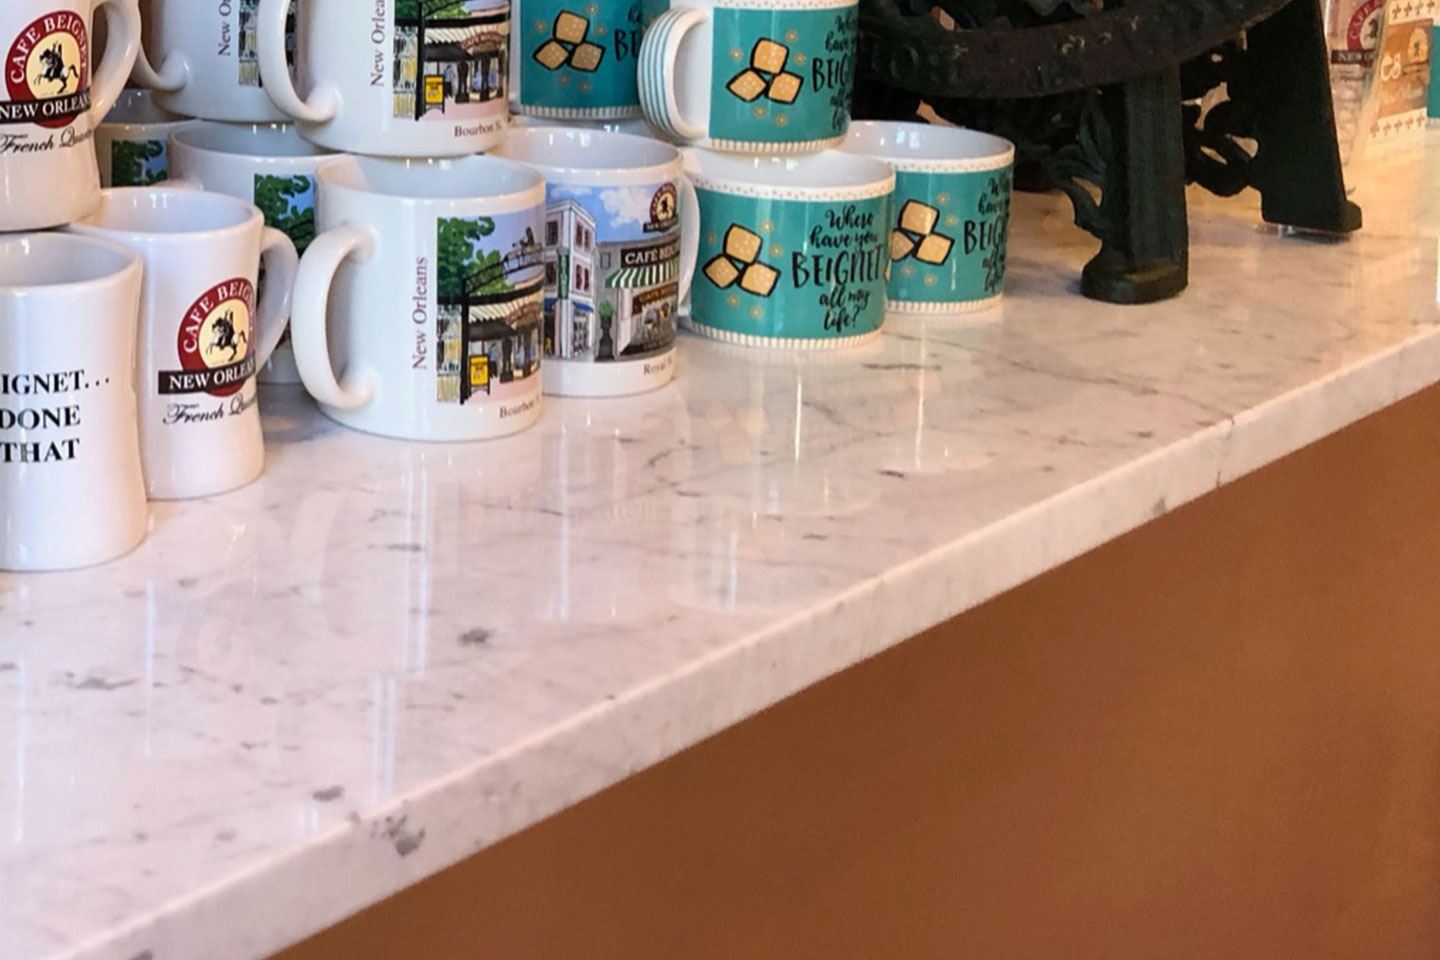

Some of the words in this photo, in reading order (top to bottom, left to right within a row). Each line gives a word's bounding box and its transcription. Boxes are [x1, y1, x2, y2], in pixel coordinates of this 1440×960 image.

[11, 27, 41, 84] CAFE
[217, 24, 232, 57] New
[370, 54, 386, 87] New
[824, 204, 874, 231] Where
[810, 224, 850, 249] have
[792, 243, 883, 289] BEIGNET
[411, 256, 428, 327] Orleans
[819, 284, 846, 308] all
[183, 296, 215, 354] CAFE
[823, 304, 860, 333] life?
[411, 335, 428, 371] New
[169, 372, 210, 390] NEW
[162, 403, 224, 425] French
